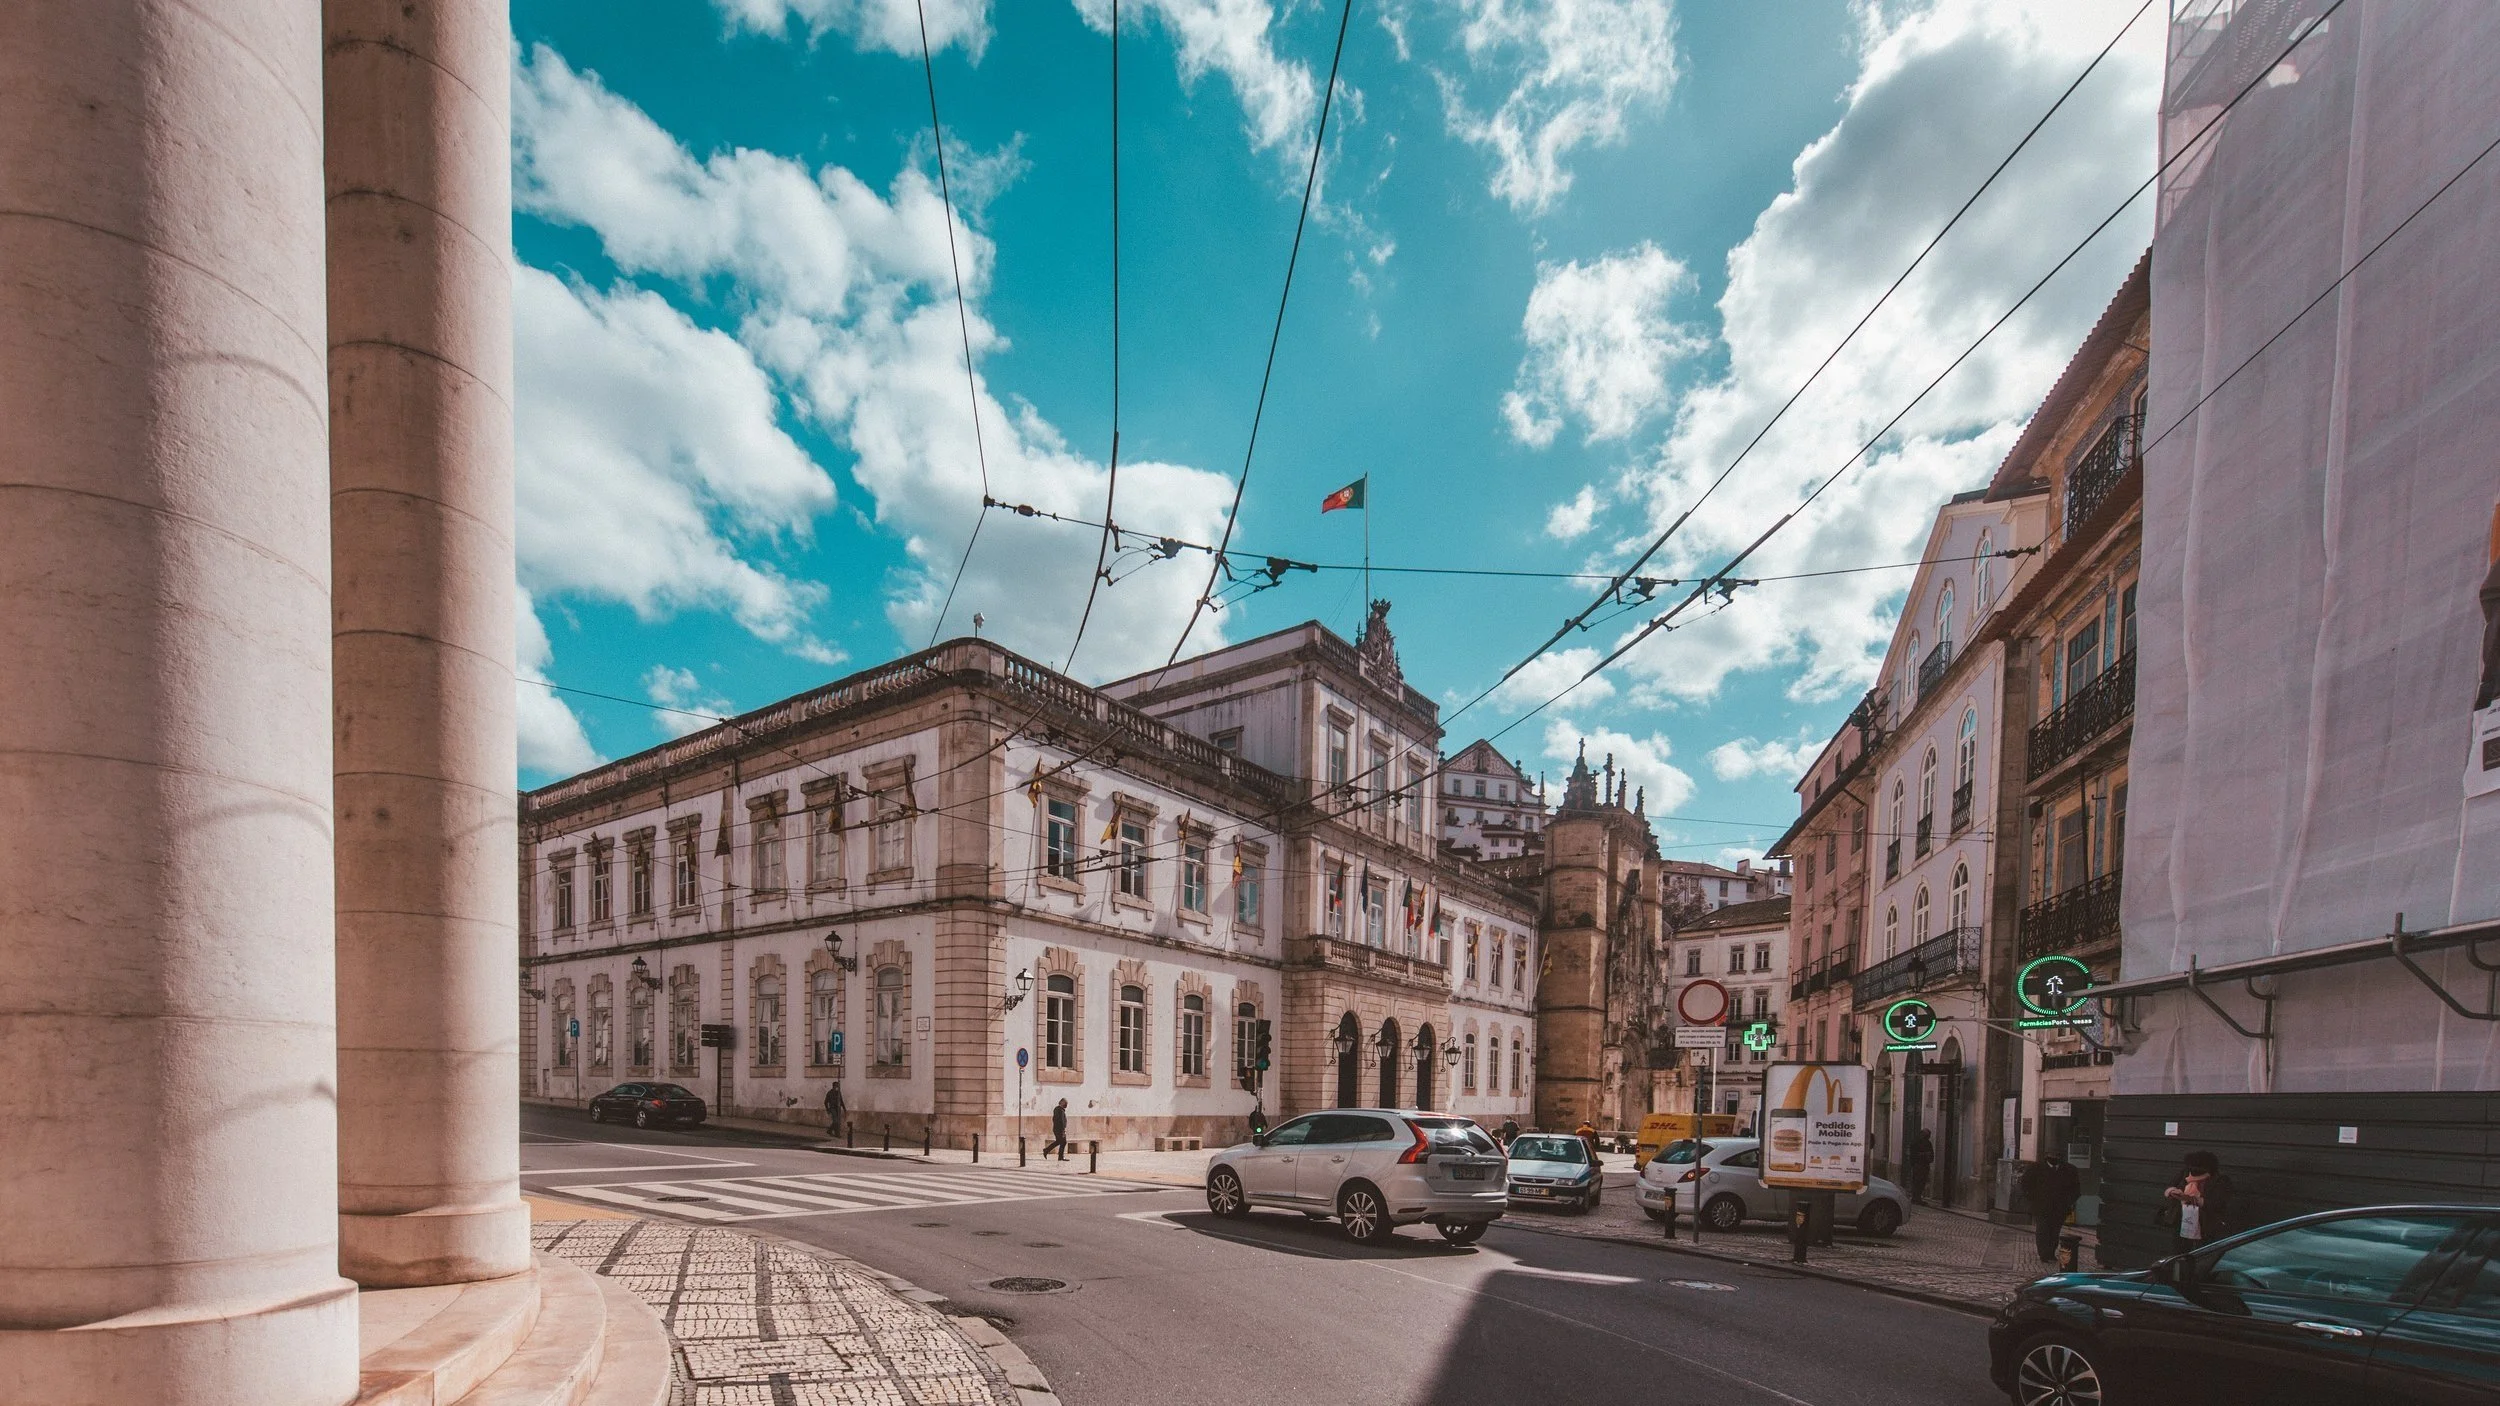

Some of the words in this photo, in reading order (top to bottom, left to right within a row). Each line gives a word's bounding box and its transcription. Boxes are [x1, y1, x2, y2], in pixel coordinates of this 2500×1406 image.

[833, 1033, 841, 1051] P
[1650, 1122, 1677, 1130] DHL
[1815, 1121, 1856, 1130] Pedidos
[1818, 1129, 1853, 1138] Mobile
